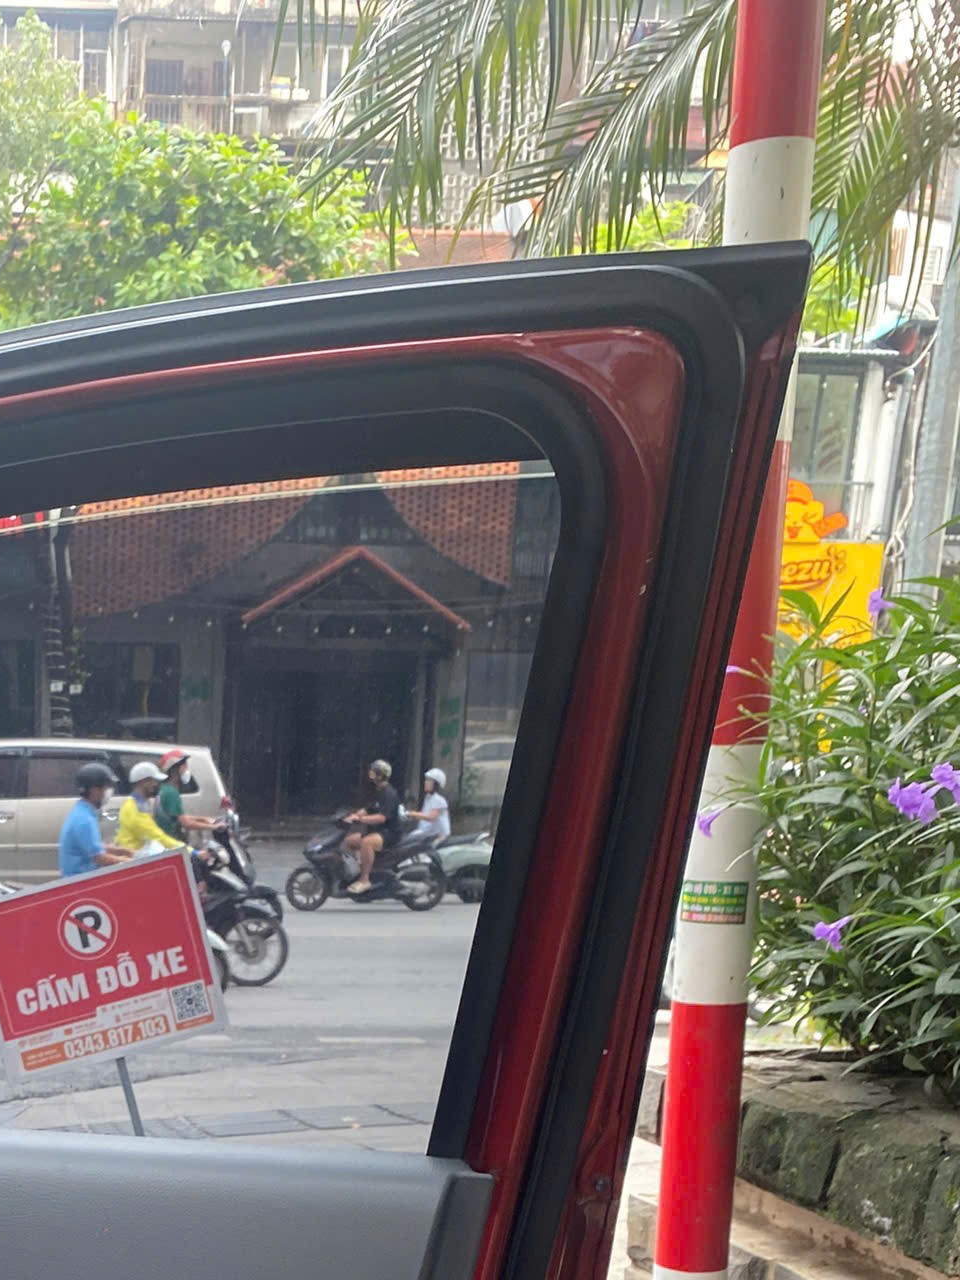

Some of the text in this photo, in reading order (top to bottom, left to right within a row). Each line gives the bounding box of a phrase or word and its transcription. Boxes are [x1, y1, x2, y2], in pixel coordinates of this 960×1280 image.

[16, 946, 188, 1016] CẤM ĐỖ XE
[63, 1016, 167, 1059] 0343.817.103
